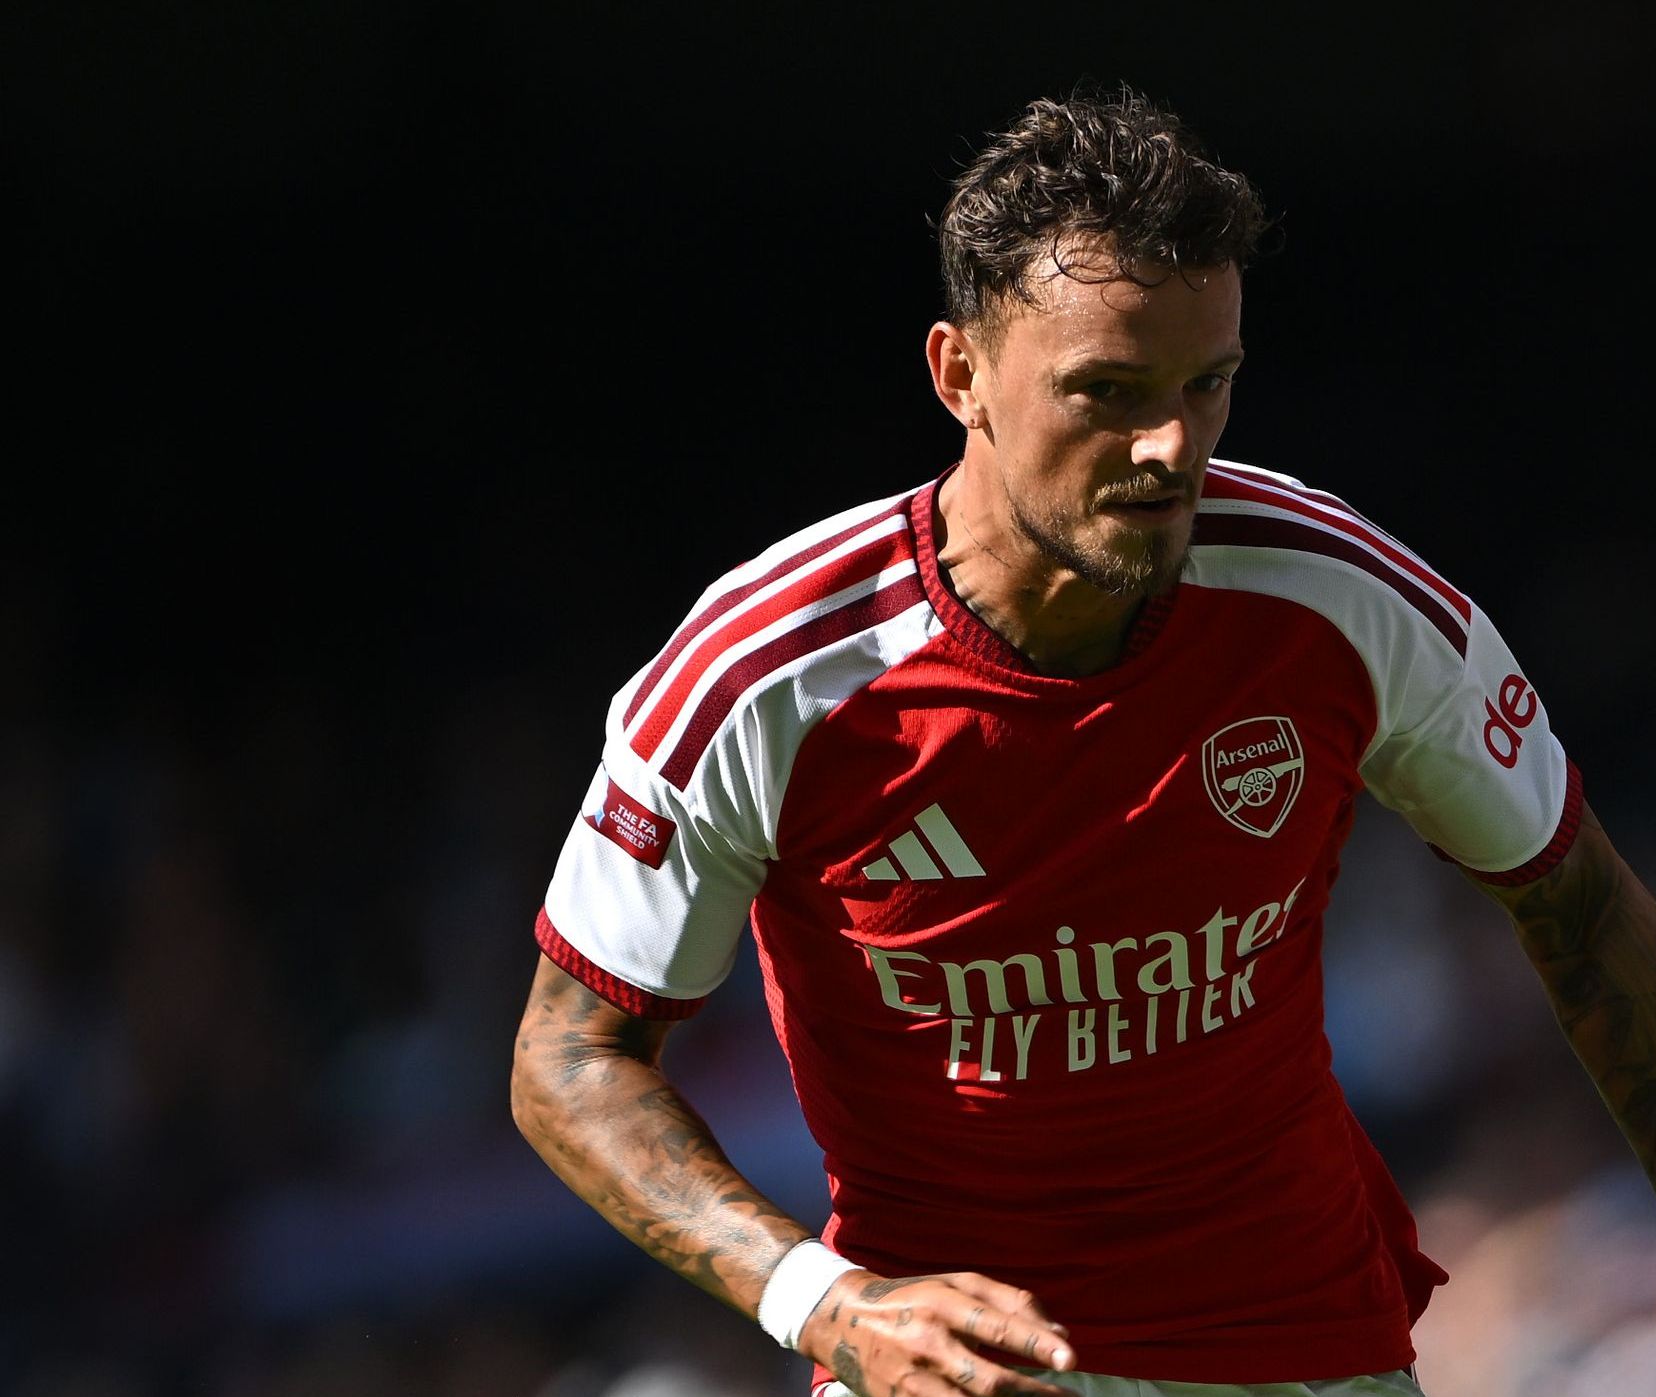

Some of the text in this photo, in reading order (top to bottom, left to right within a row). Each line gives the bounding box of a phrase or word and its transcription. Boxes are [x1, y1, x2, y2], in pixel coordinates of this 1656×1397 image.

[1216, 733, 1286, 769] Arsenal
[609, 810, 660, 848] COMMUNITY
[615, 825, 645, 850] SHIELD
[616, 803, 657, 838] THE FA
[947, 1014, 1041, 1082] FLY
